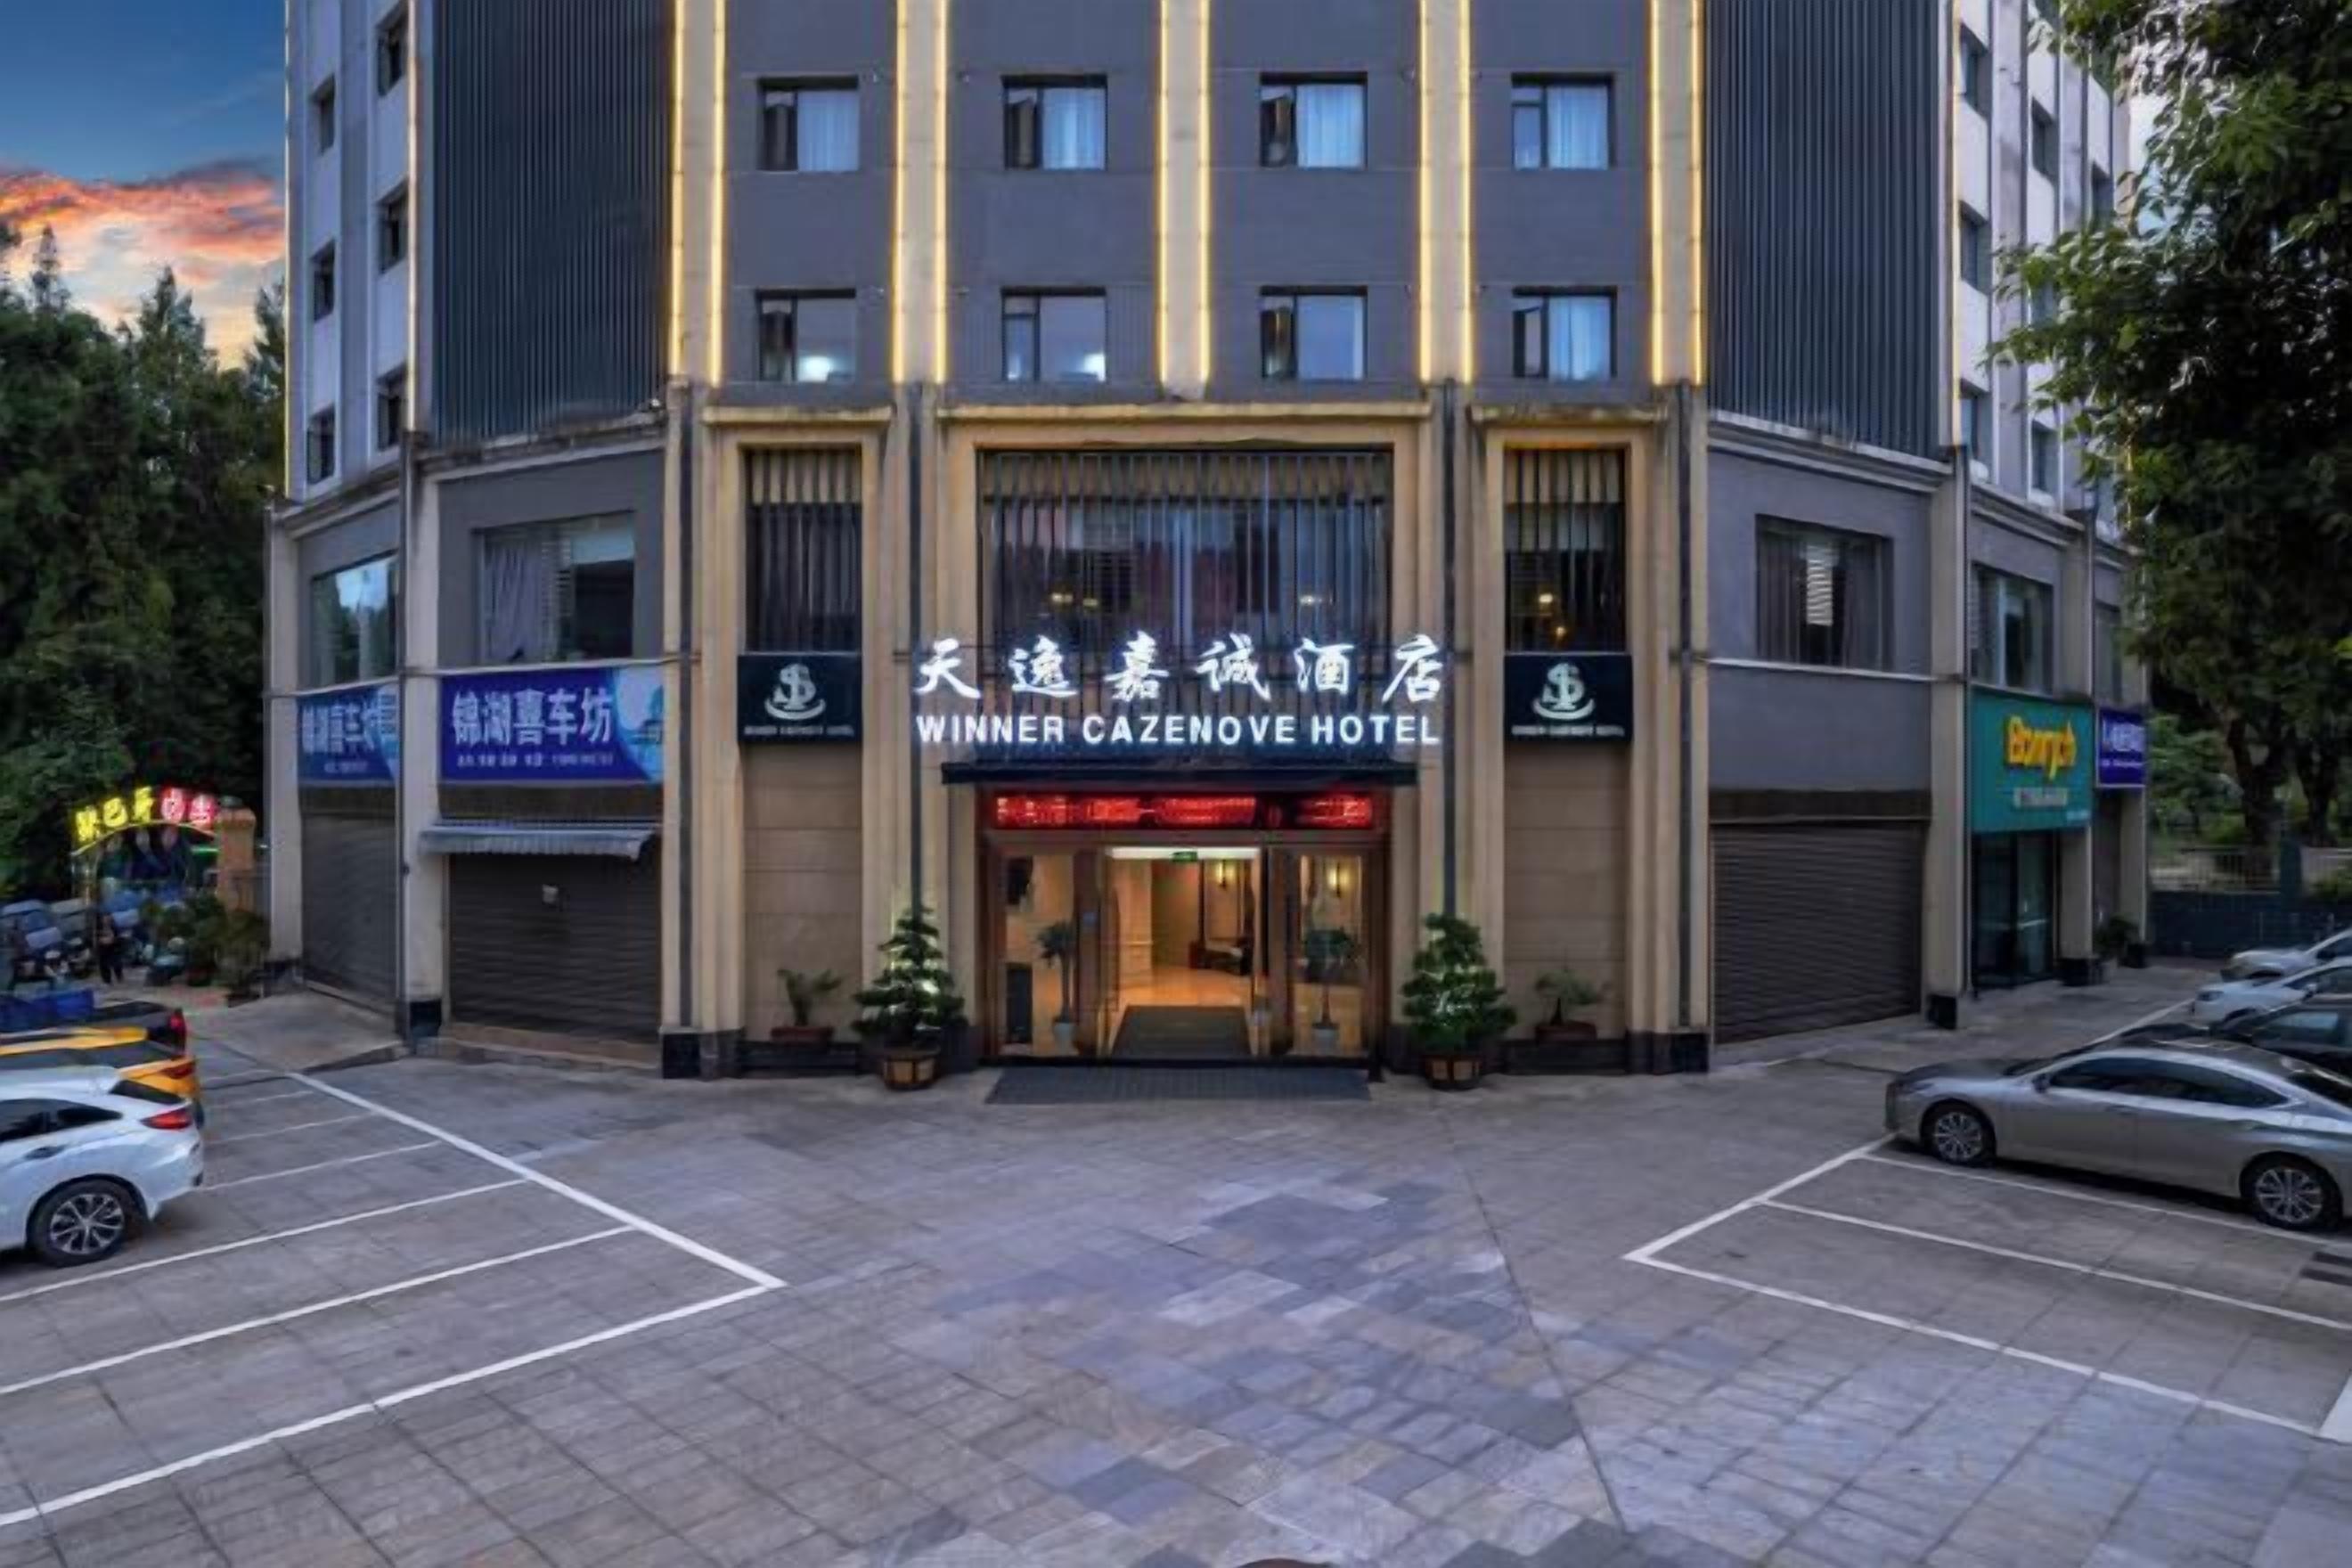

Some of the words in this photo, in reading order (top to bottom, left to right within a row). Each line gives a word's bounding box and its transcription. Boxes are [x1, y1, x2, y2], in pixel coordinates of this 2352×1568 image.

[916, 715, 1065, 744] WINNER
[1082, 715, 1295, 745] CAZENOVE
[1311, 715, 1441, 744] HOTEL
